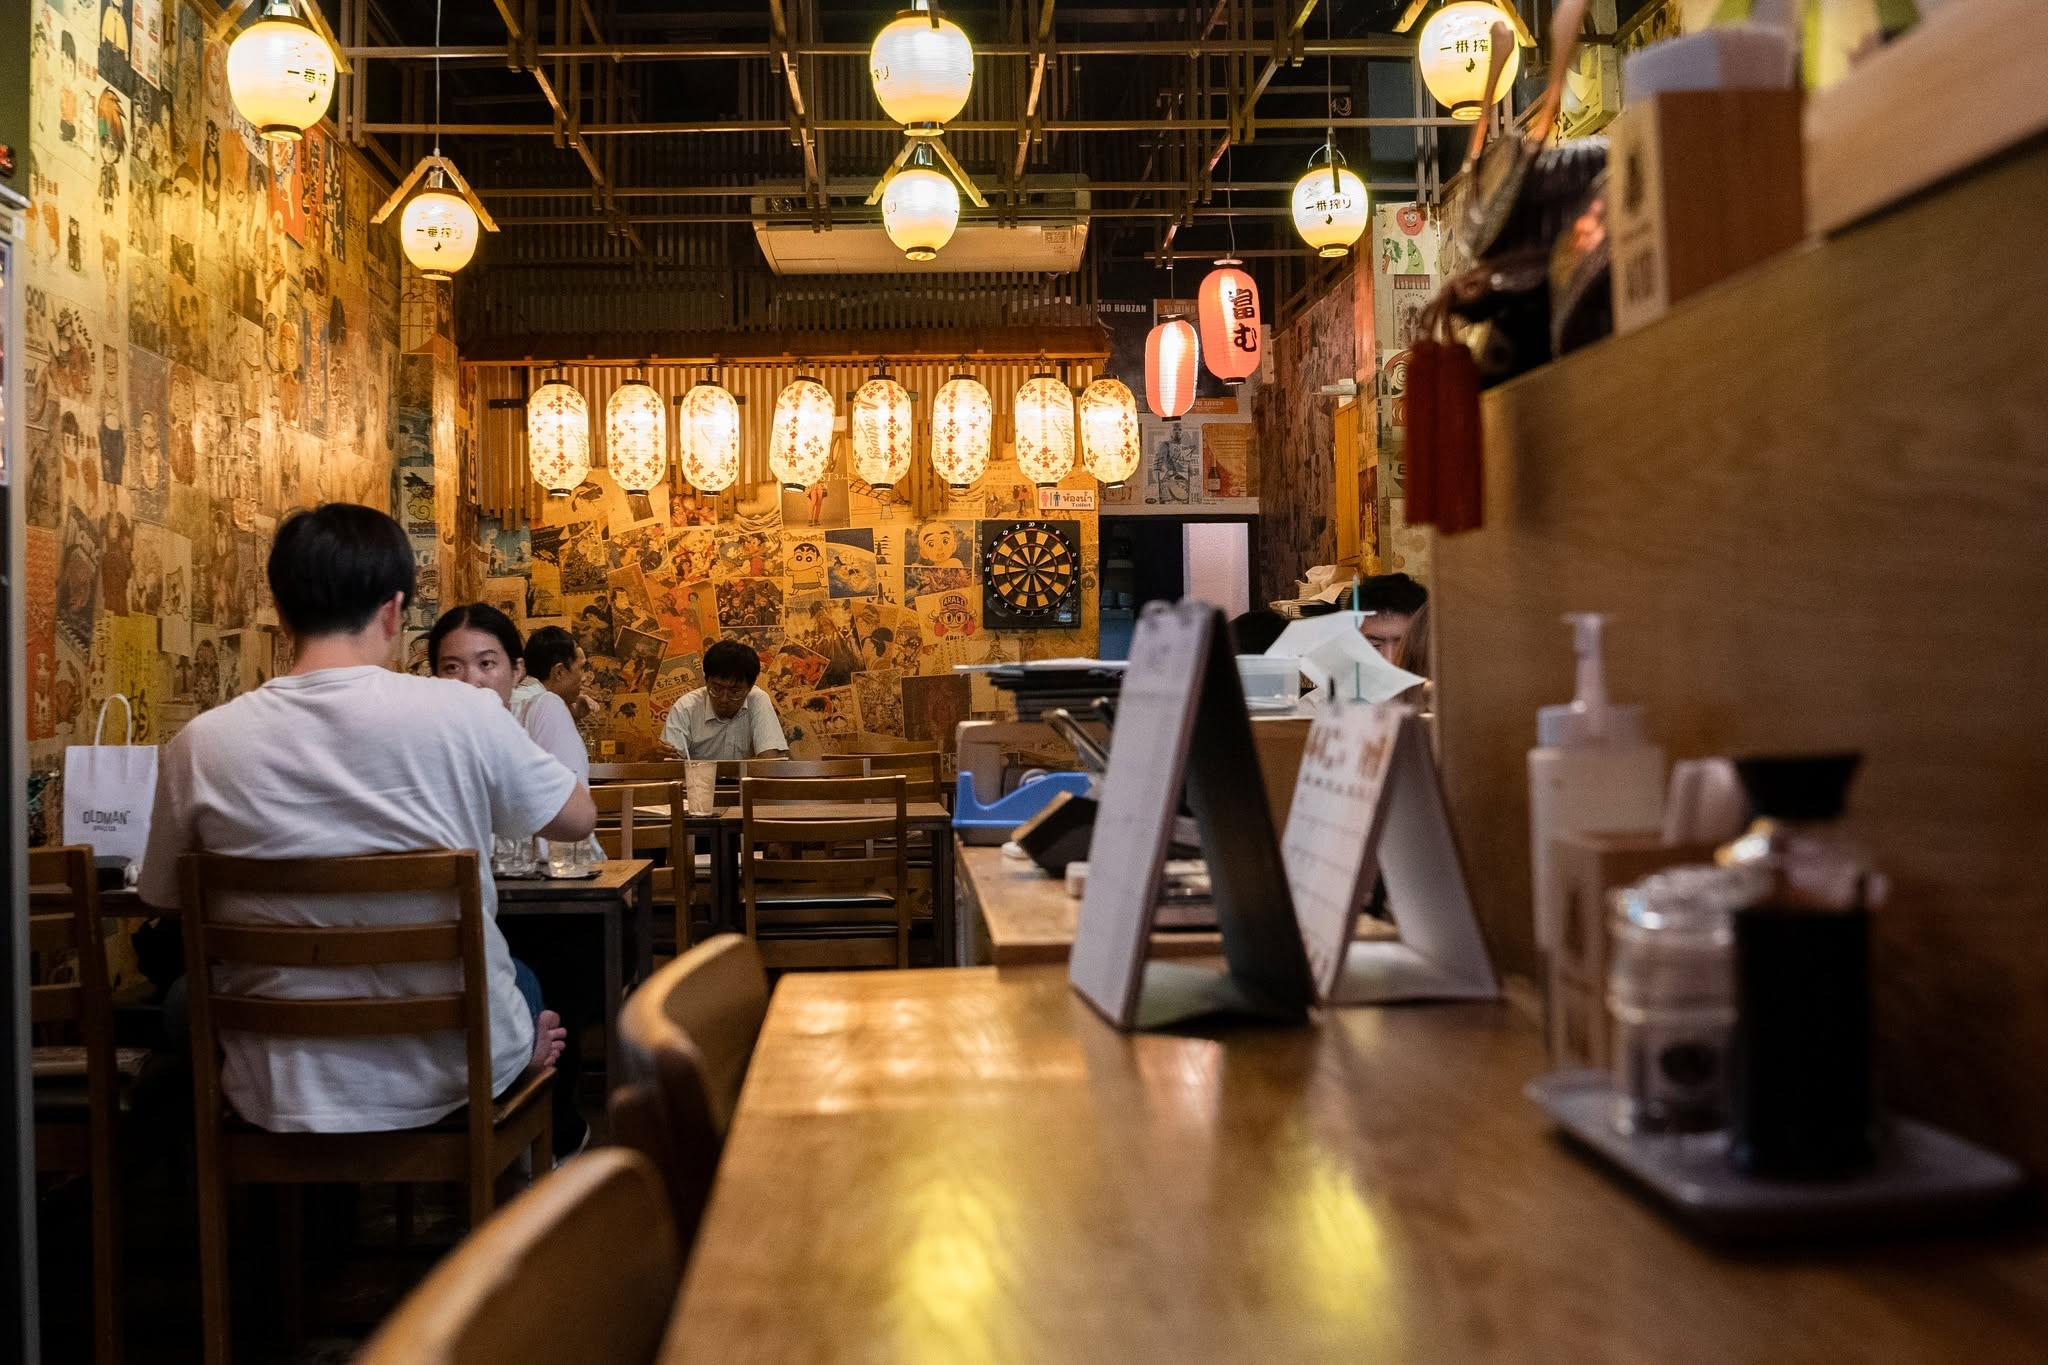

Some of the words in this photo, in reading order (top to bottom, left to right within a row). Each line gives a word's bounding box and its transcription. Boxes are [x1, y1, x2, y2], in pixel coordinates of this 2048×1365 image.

[1305, 198, 1352, 212] 一番搾り
[1062, 491, 1093, 502] ห้องน้ำ
[942, 595, 966, 607] ARALE
[82, 809, 128, 825] OLDMAN
